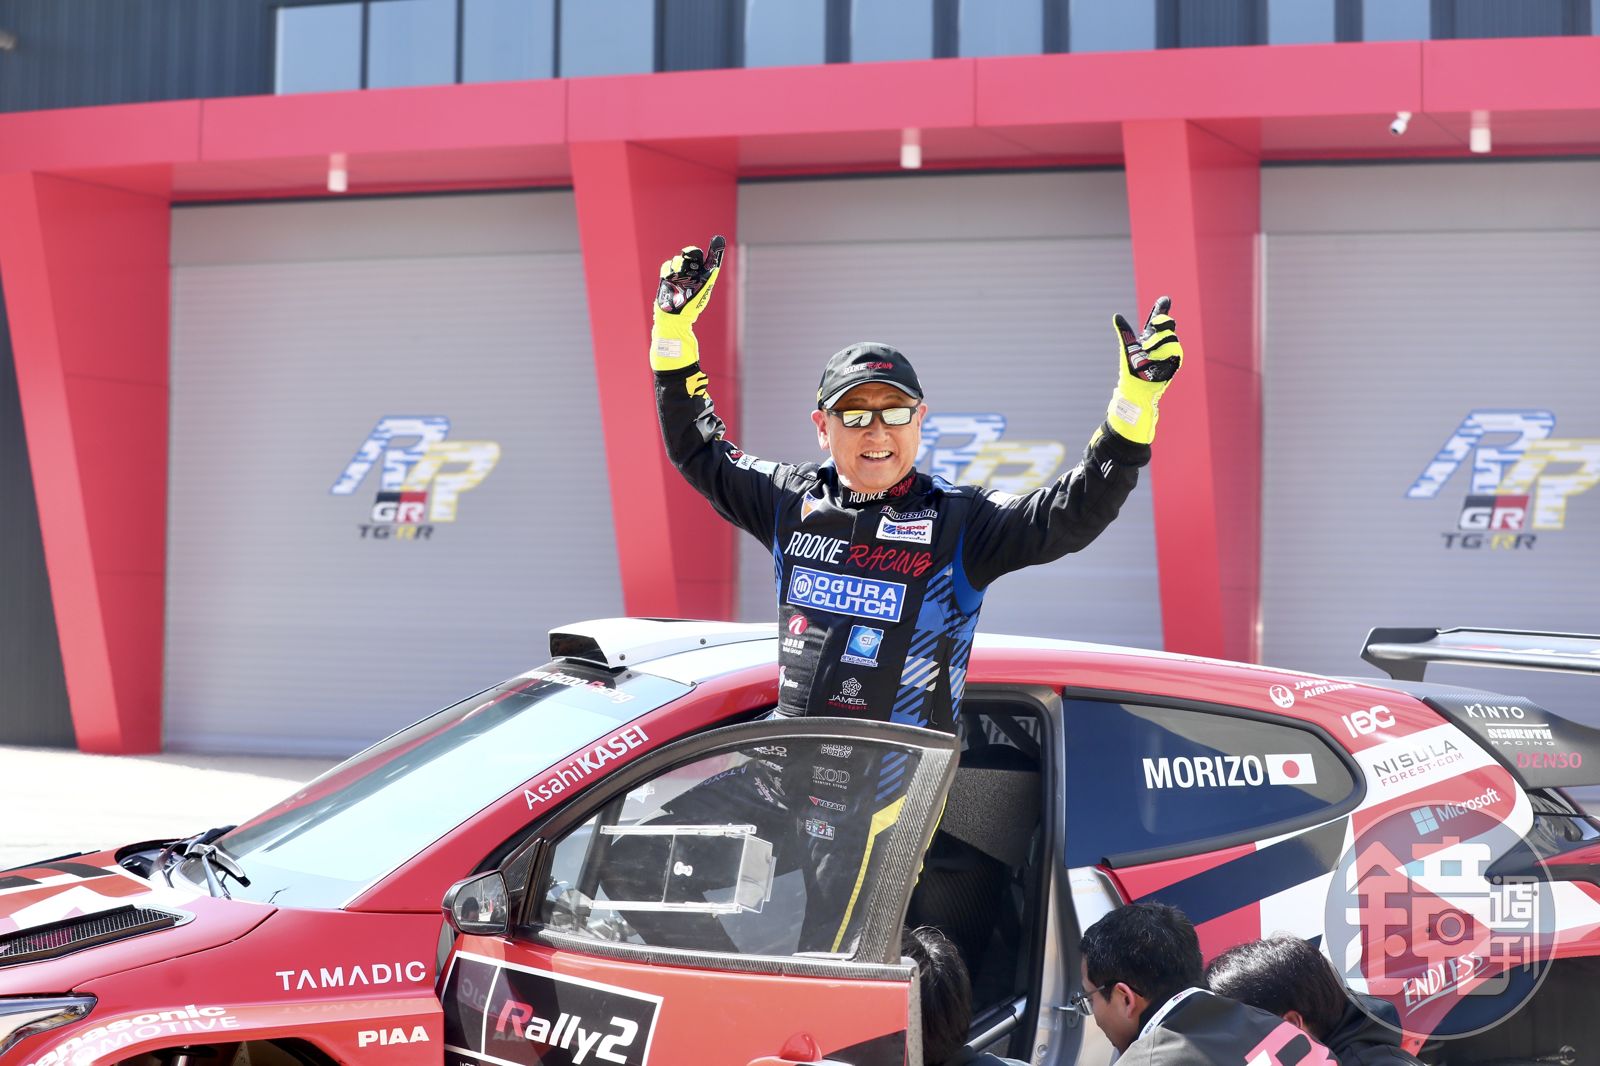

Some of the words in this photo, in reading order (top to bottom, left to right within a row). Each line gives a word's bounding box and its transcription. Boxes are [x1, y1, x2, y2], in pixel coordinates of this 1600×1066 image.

[371, 501, 426, 523] GR
[880, 505, 938, 521] BRIDGESTONE
[1458, 507, 1526, 530] GR
[896, 525, 928, 533] Super
[784, 531, 849, 565] ROOKIE
[846, 544, 934, 577] RACING
[814, 578, 897, 602] OGURA
[811, 590, 896, 617] CLUTCH
[1294, 680, 1330, 690] JAPAN
[828, 694, 867, 705] JAMEEL
[1465, 703, 1525, 719] KINTO
[820, 748, 852, 758] PURDY
[1373, 739, 1458, 778] NISULA
[1516, 752, 1583, 769] DENSO
[812, 765, 850, 784] KOD
[1142, 755, 1264, 789] MORIZO
[1437, 787, 1501, 822] Microsoft
[276, 961, 426, 991] TAMADIC
[1402, 952, 1483, 1008] ENDLESS
[358, 1026, 430, 1047] PIAA
[495, 999, 639, 1065] Rally2
